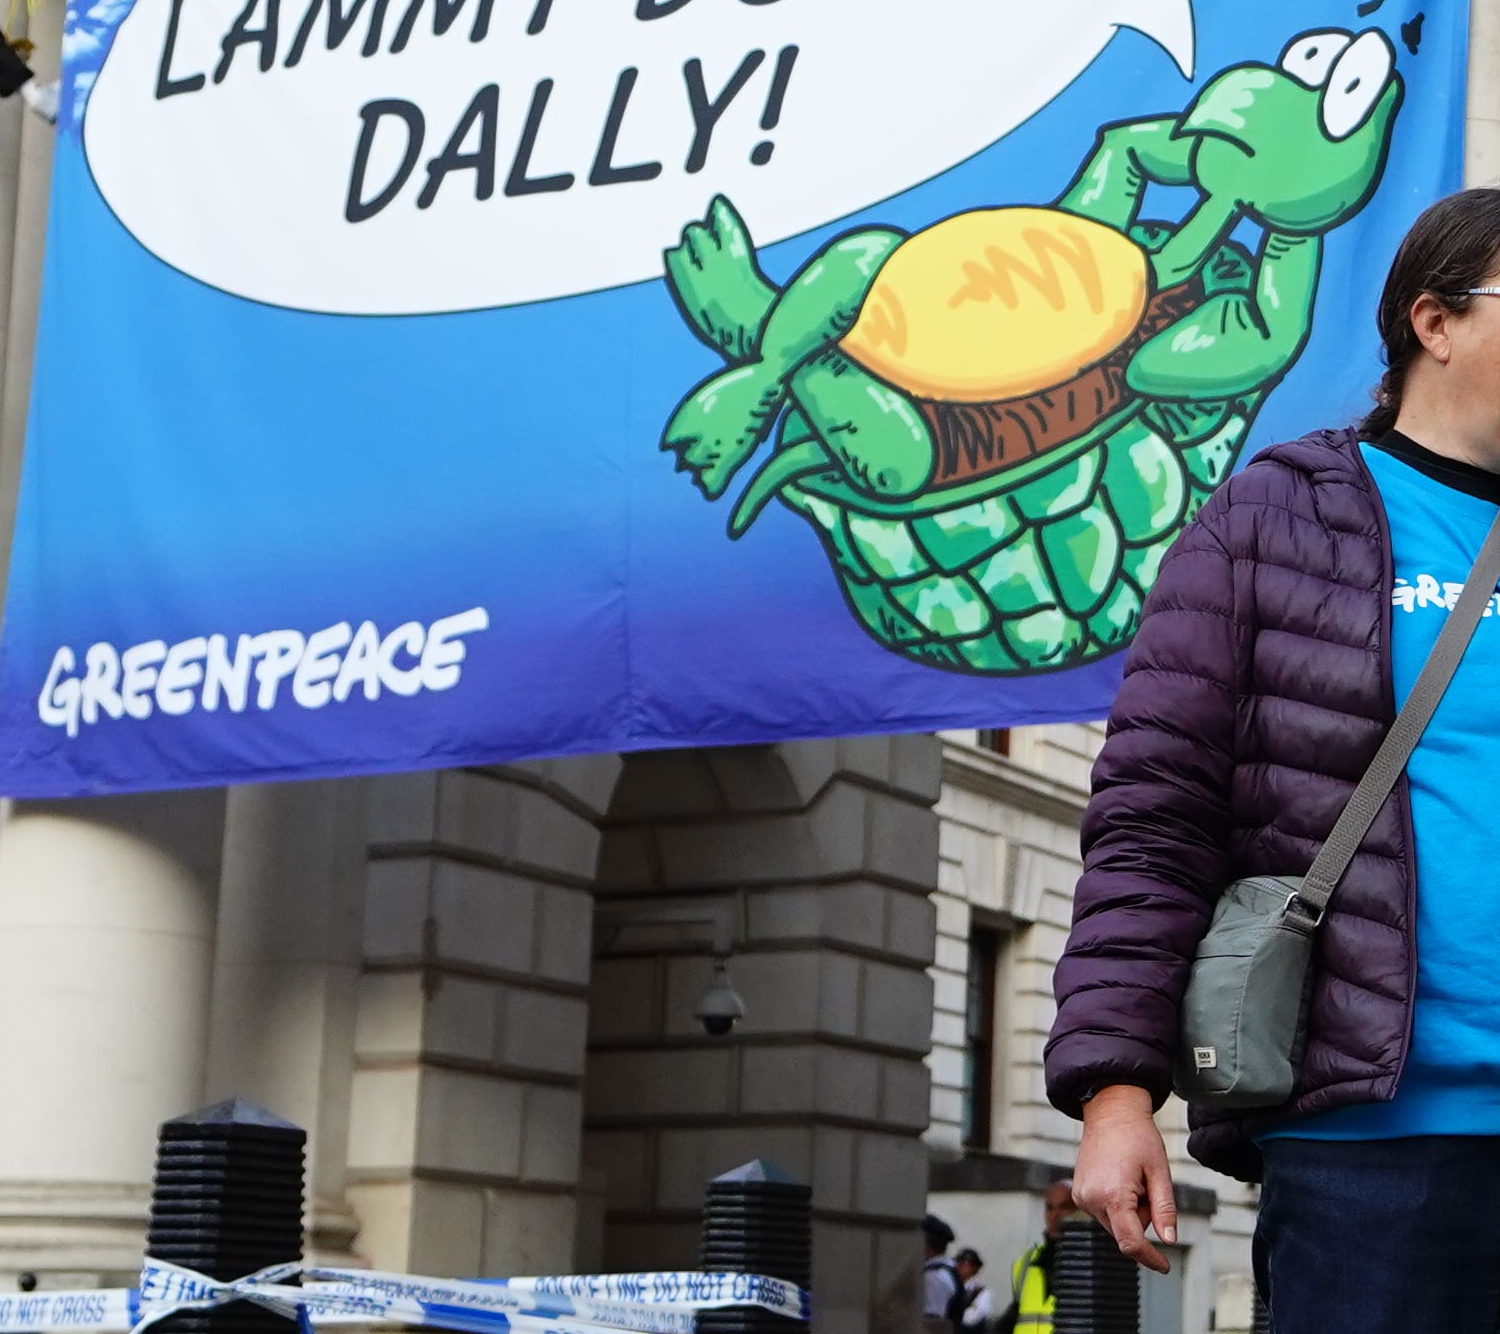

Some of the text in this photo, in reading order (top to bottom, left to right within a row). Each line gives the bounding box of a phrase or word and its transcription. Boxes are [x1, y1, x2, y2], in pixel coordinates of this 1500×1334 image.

[344, 44, 800, 223] DALLY!
[38, 607, 489, 734] GREENPEACE
[18, 1297, 49, 1325] NOT
[52, 1295, 107, 1323] CROSS
